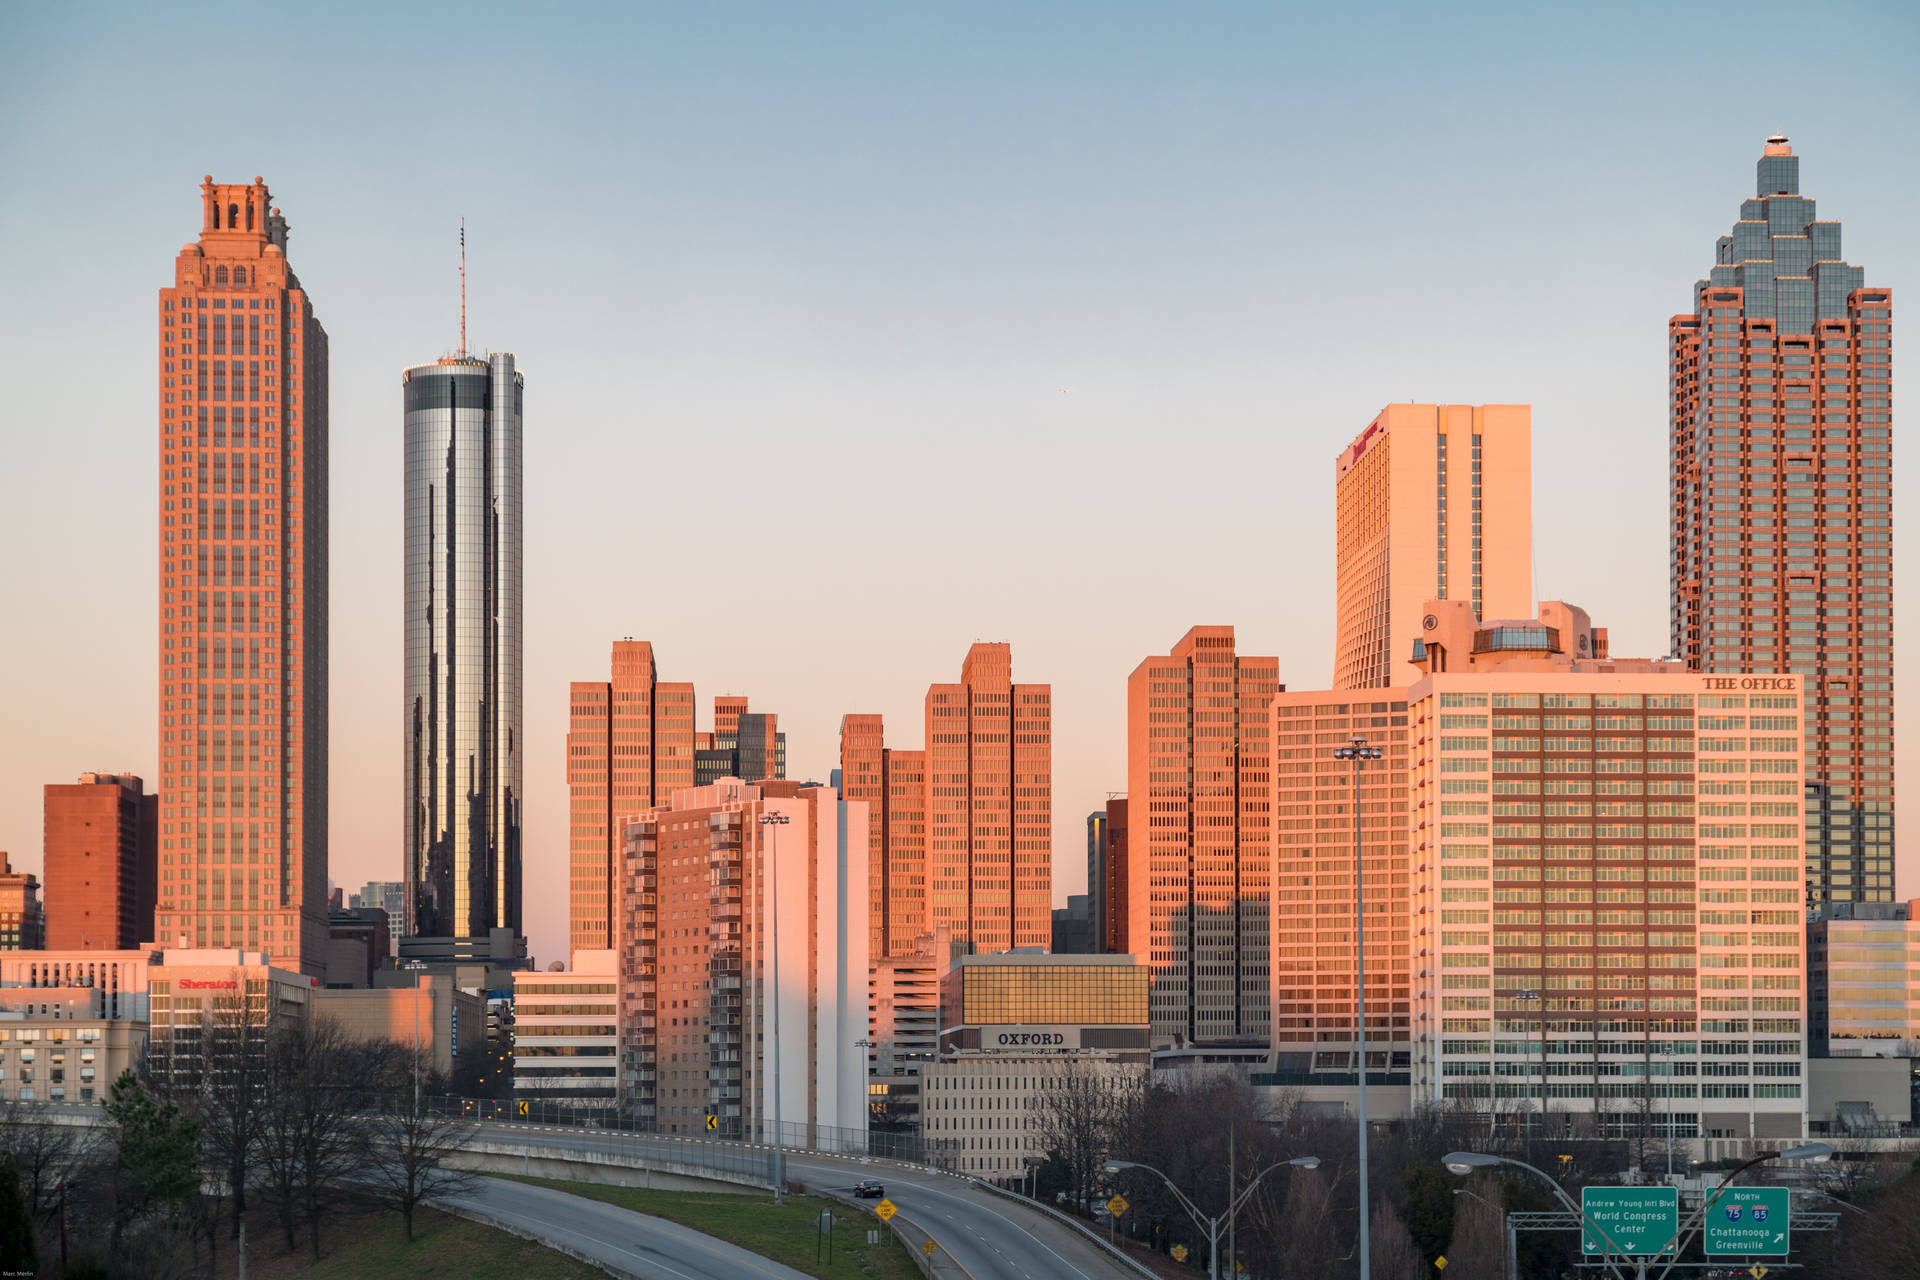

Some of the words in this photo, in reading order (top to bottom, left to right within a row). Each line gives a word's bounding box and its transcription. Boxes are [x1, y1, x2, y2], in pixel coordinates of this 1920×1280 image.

[1702, 678, 1737, 690] THE
[1741, 678, 1796, 690] OFFICE
[179, 979, 237, 989] Sheraton
[998, 1034, 1064, 1044] OXFORD
[1618, 1200, 1642, 1208] Young
[1594, 1212, 1620, 1220] World
[1624, 1212, 1666, 1222] Congress
[1728, 1210, 1740, 1218] 75
[1754, 1210, 1766, 1220] 85
[1710, 1228, 1770, 1238] Chattanooga
[1716, 1240, 1764, 1249] Greenville
